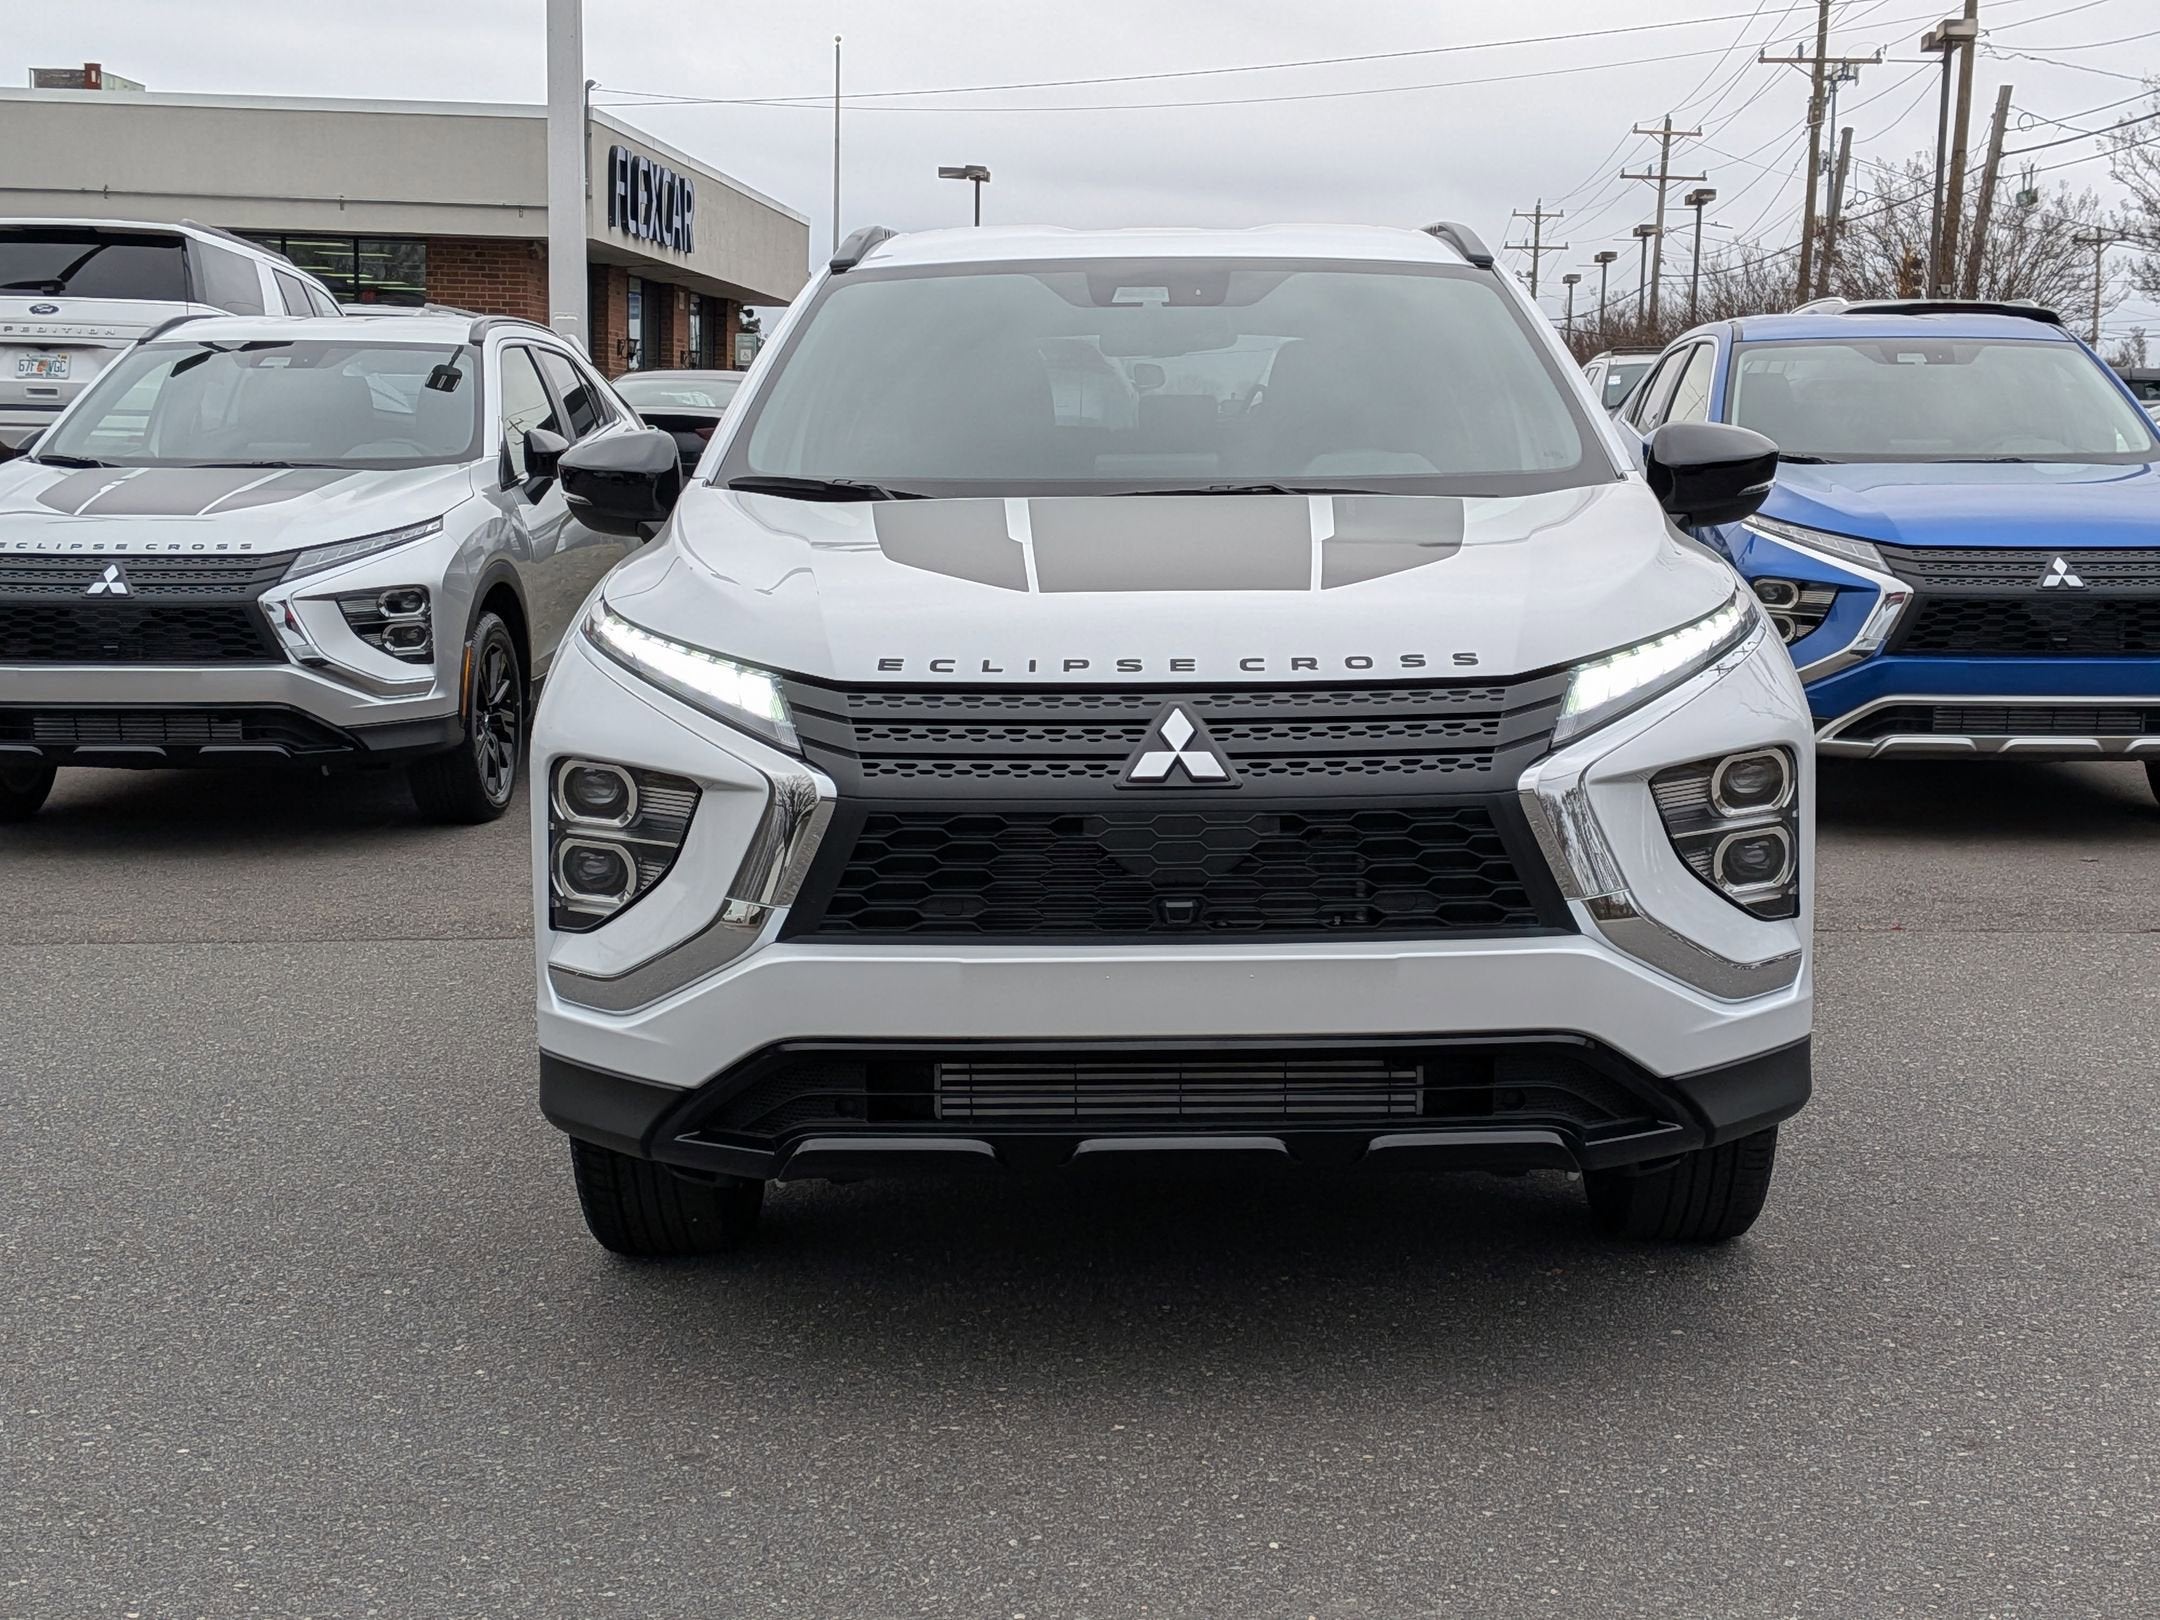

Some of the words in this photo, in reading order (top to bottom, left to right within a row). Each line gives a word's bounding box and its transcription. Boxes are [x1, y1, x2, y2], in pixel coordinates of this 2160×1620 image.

[608, 145, 695, 254] FLEXCAR
[145, 543, 253, 551] CROSS
[877, 658, 1197, 673] ECLIPSE
[1239, 652, 1479, 672] CROSS
